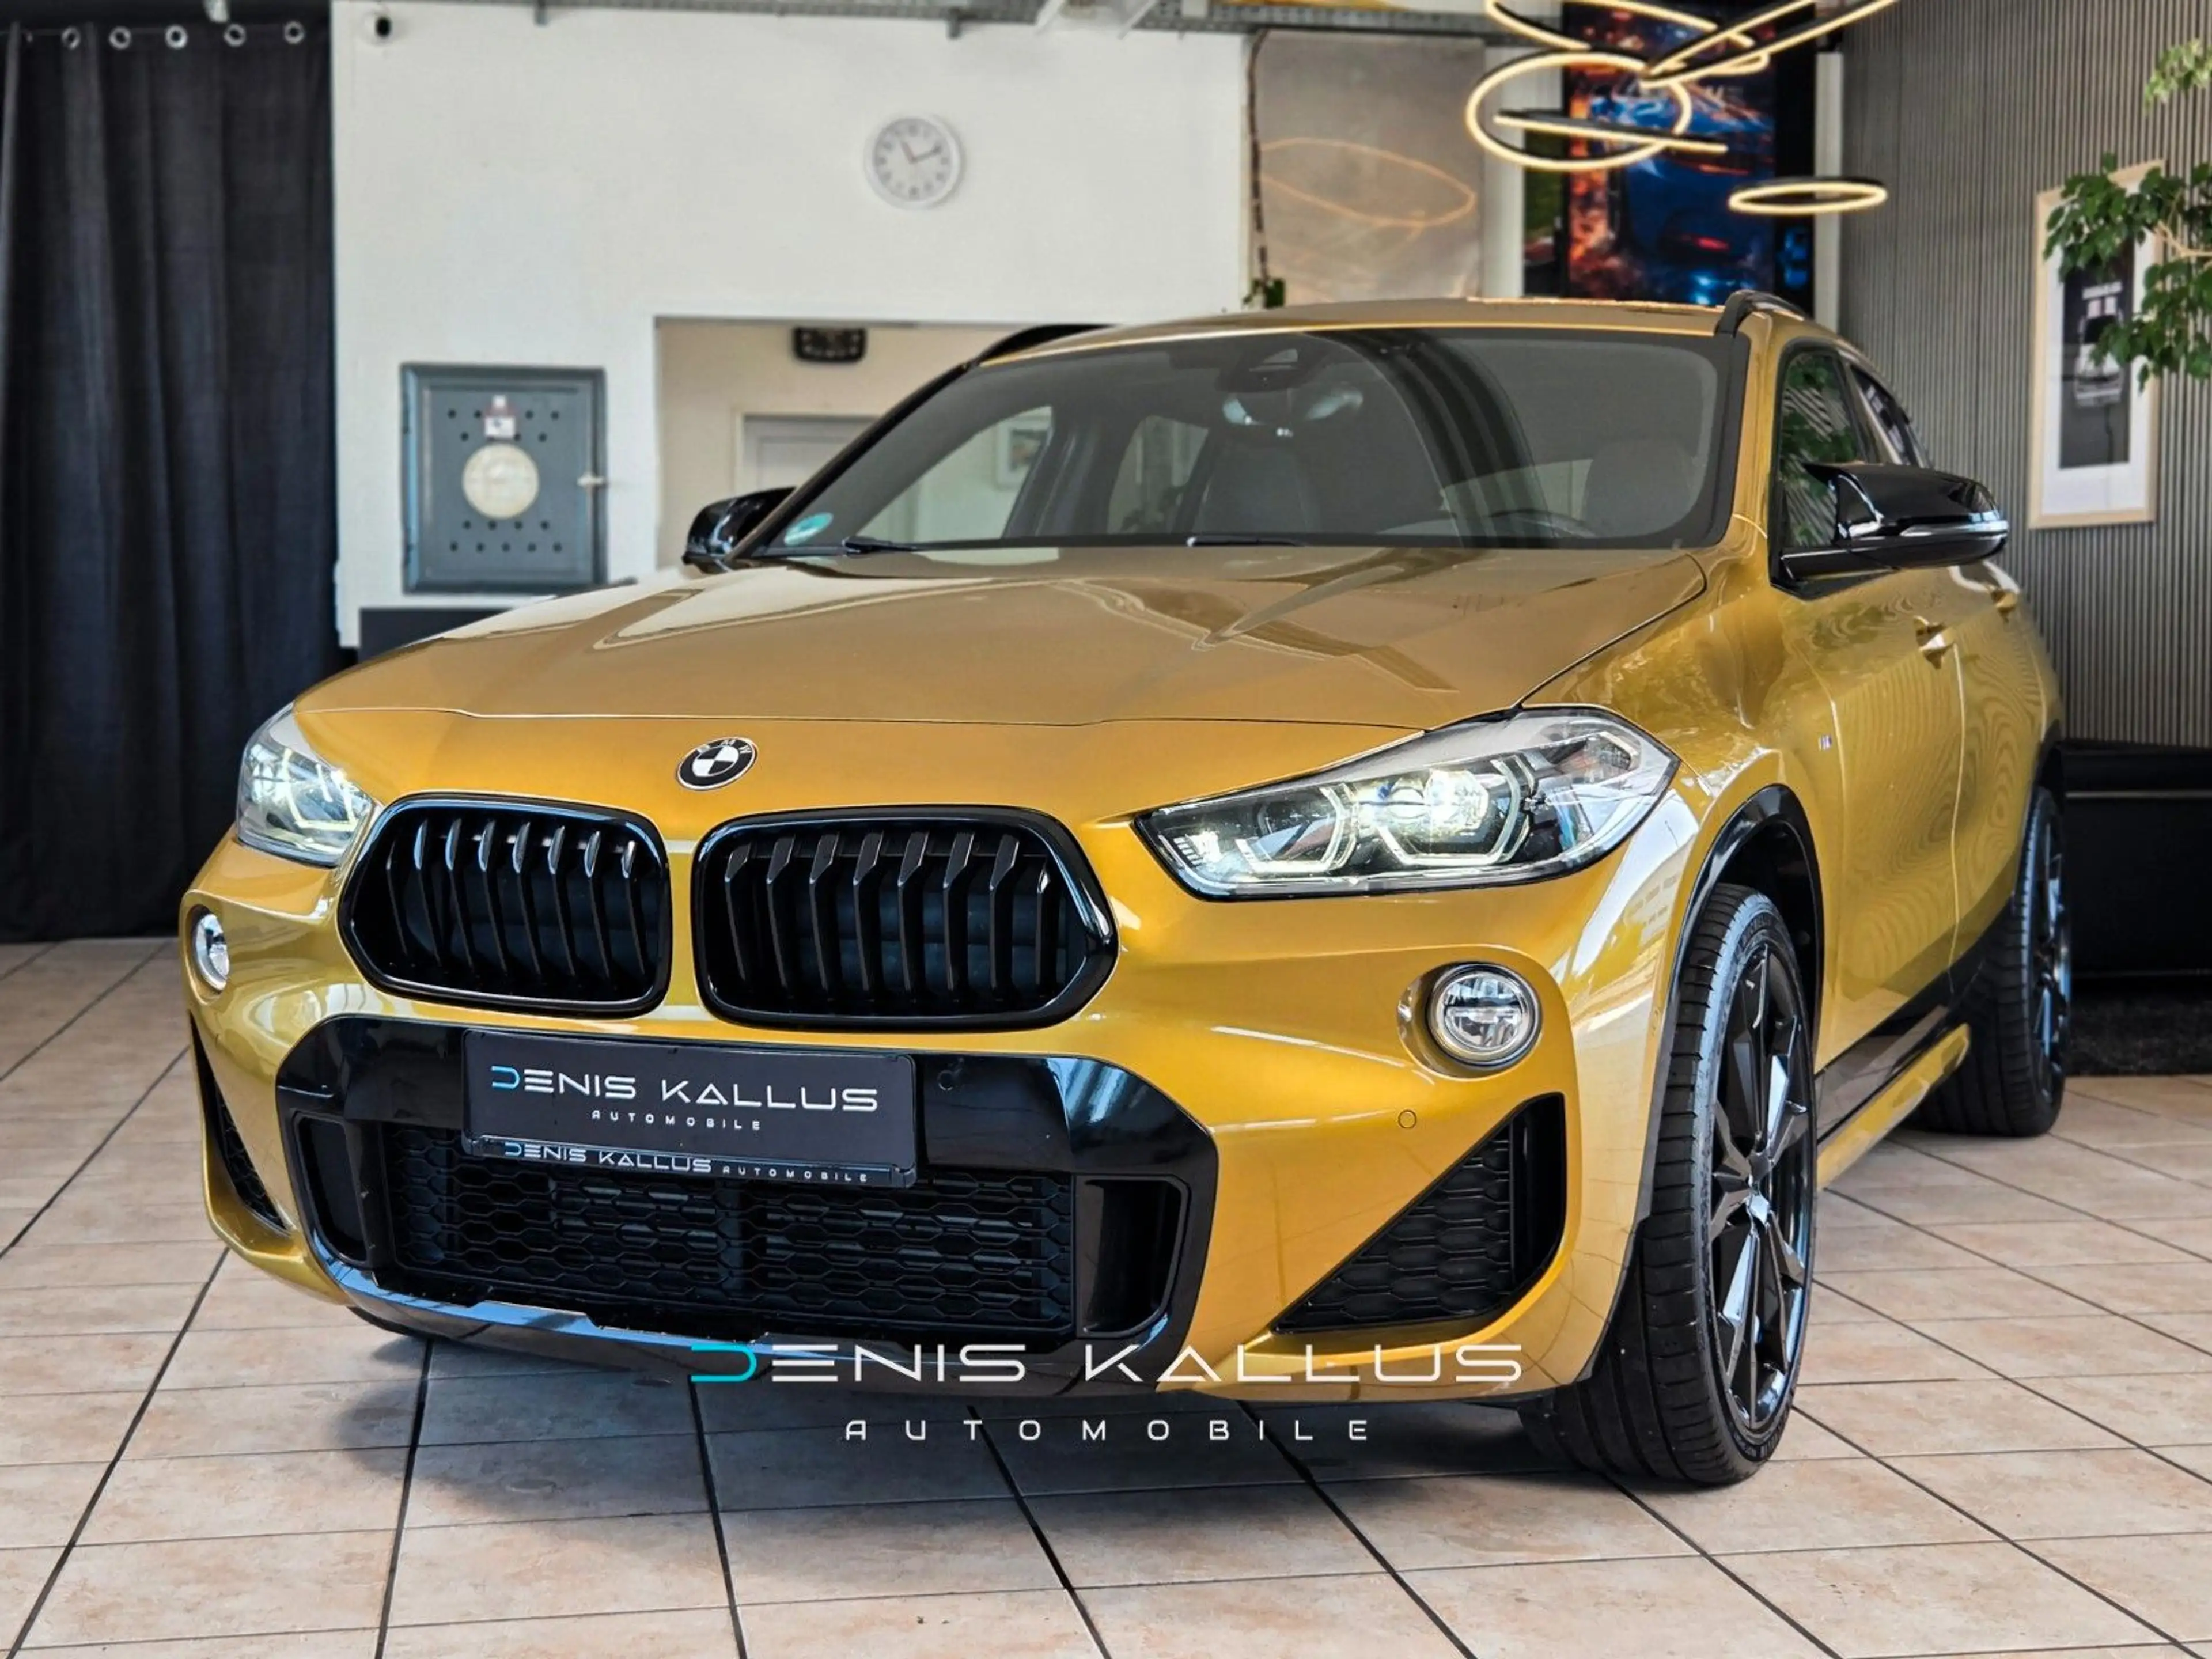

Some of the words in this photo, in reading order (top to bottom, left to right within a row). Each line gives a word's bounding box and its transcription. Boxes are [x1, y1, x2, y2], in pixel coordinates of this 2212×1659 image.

[491, 1066, 637, 1099] DENIS
[661, 1079, 878, 1113] KALLUS
[592, 1109, 761, 1131] AUTOMOBILE
[504, 1141, 586, 1162] DENIS
[599, 1150, 712, 1173] KALLUS
[722, 1165, 867, 1182] AUTOMOBILE
